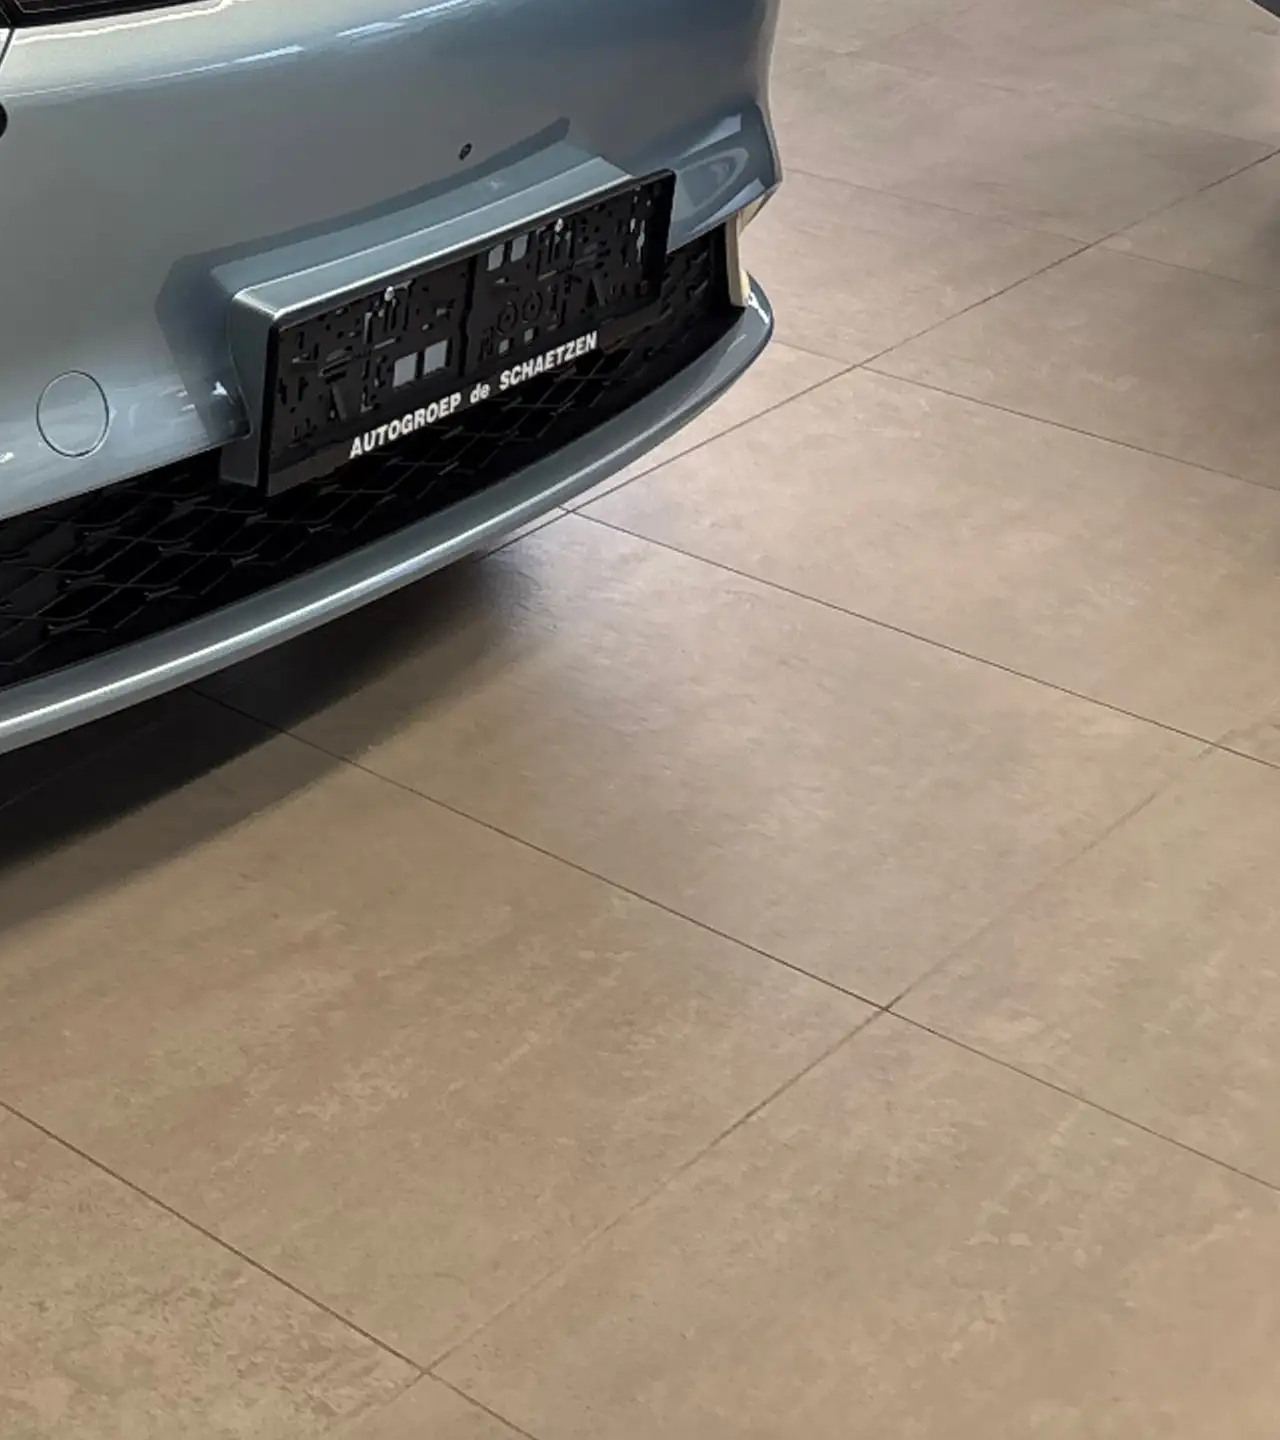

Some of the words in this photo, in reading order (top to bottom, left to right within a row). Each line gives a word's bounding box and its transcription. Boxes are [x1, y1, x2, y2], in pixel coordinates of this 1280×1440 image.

[349, 392, 462, 459] AUTOGROEP
[469, 382, 490, 404] de
[499, 330, 598, 391] SCHAETZEN
